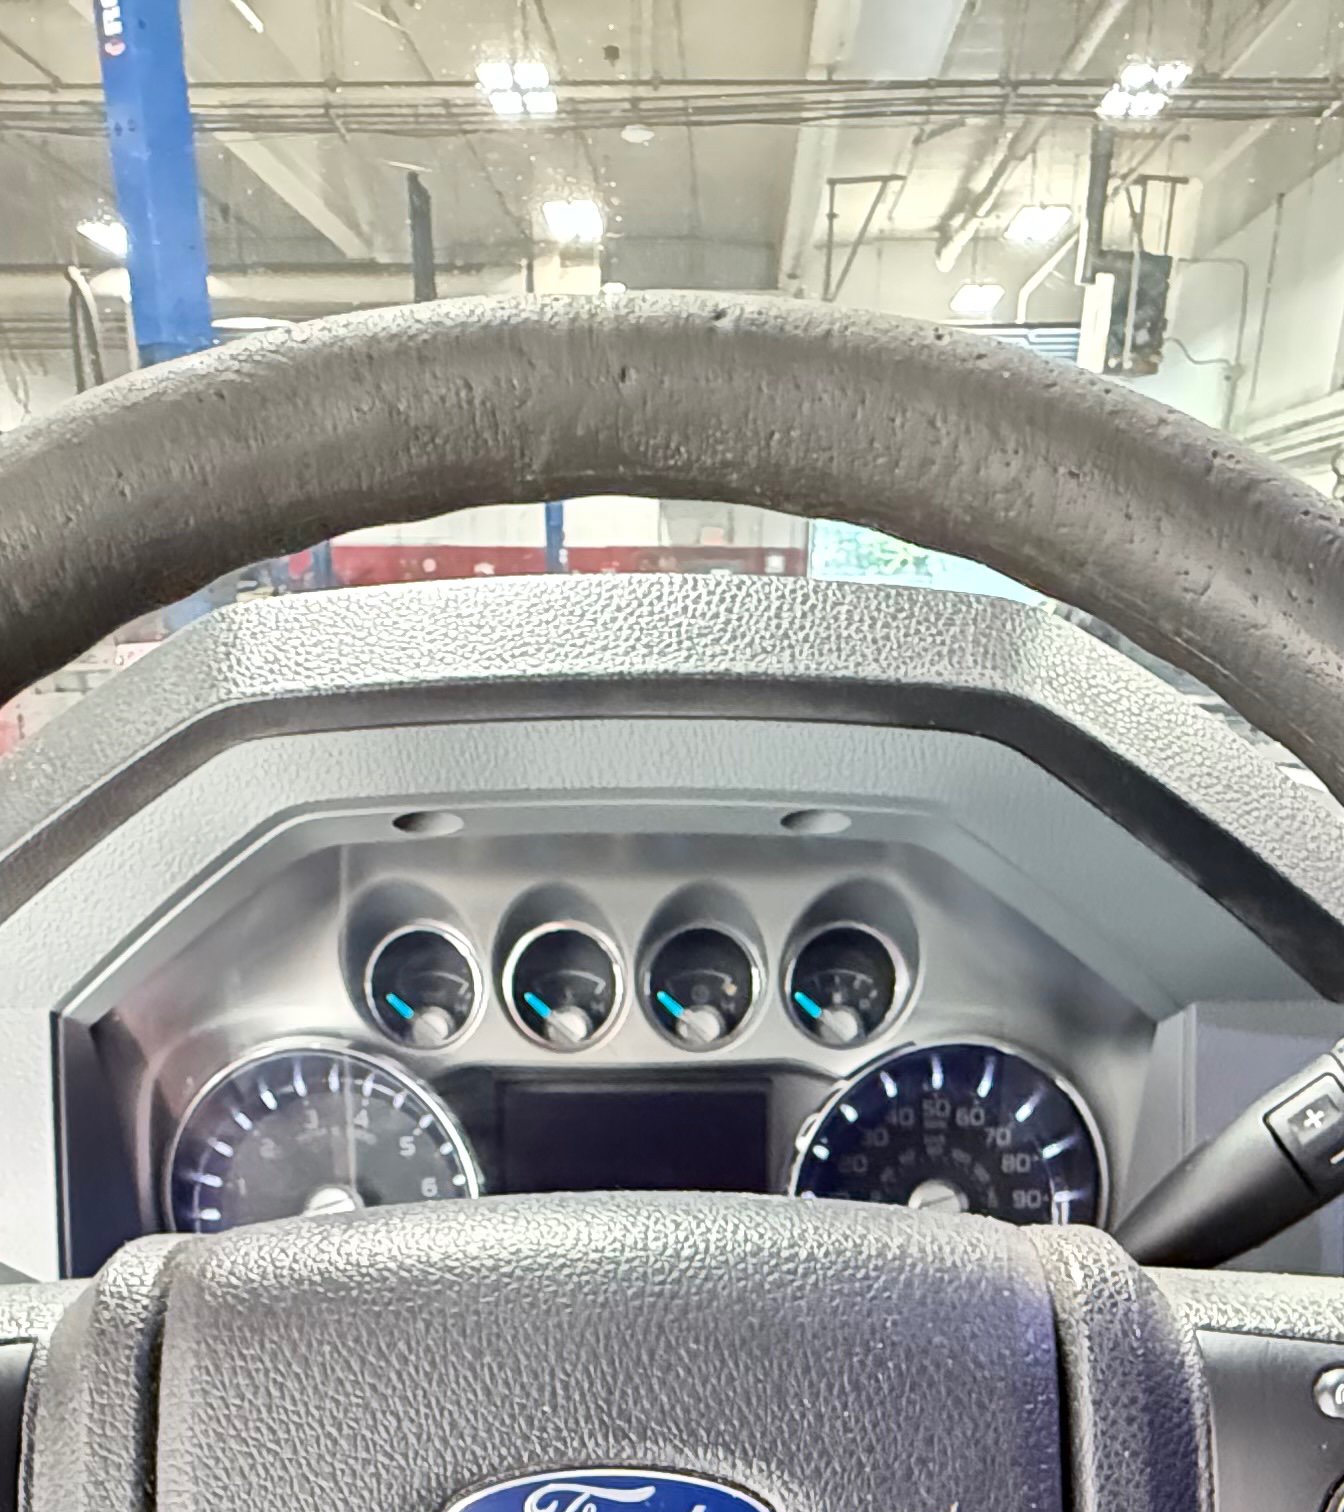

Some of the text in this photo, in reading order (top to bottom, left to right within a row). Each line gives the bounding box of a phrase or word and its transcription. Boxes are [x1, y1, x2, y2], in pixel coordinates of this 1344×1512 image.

[887, 1107, 915, 1127] 40
[923, 1099, 951, 1118] 50
[956, 1107, 985, 1126] 60
[399, 1135, 416, 1157] 5
[984, 1127, 1012, 1146] 70
[1001, 1153, 1031, 1173] 80
[422, 1177, 438, 1197] 6
[1012, 1189, 1041, 1209] 90
